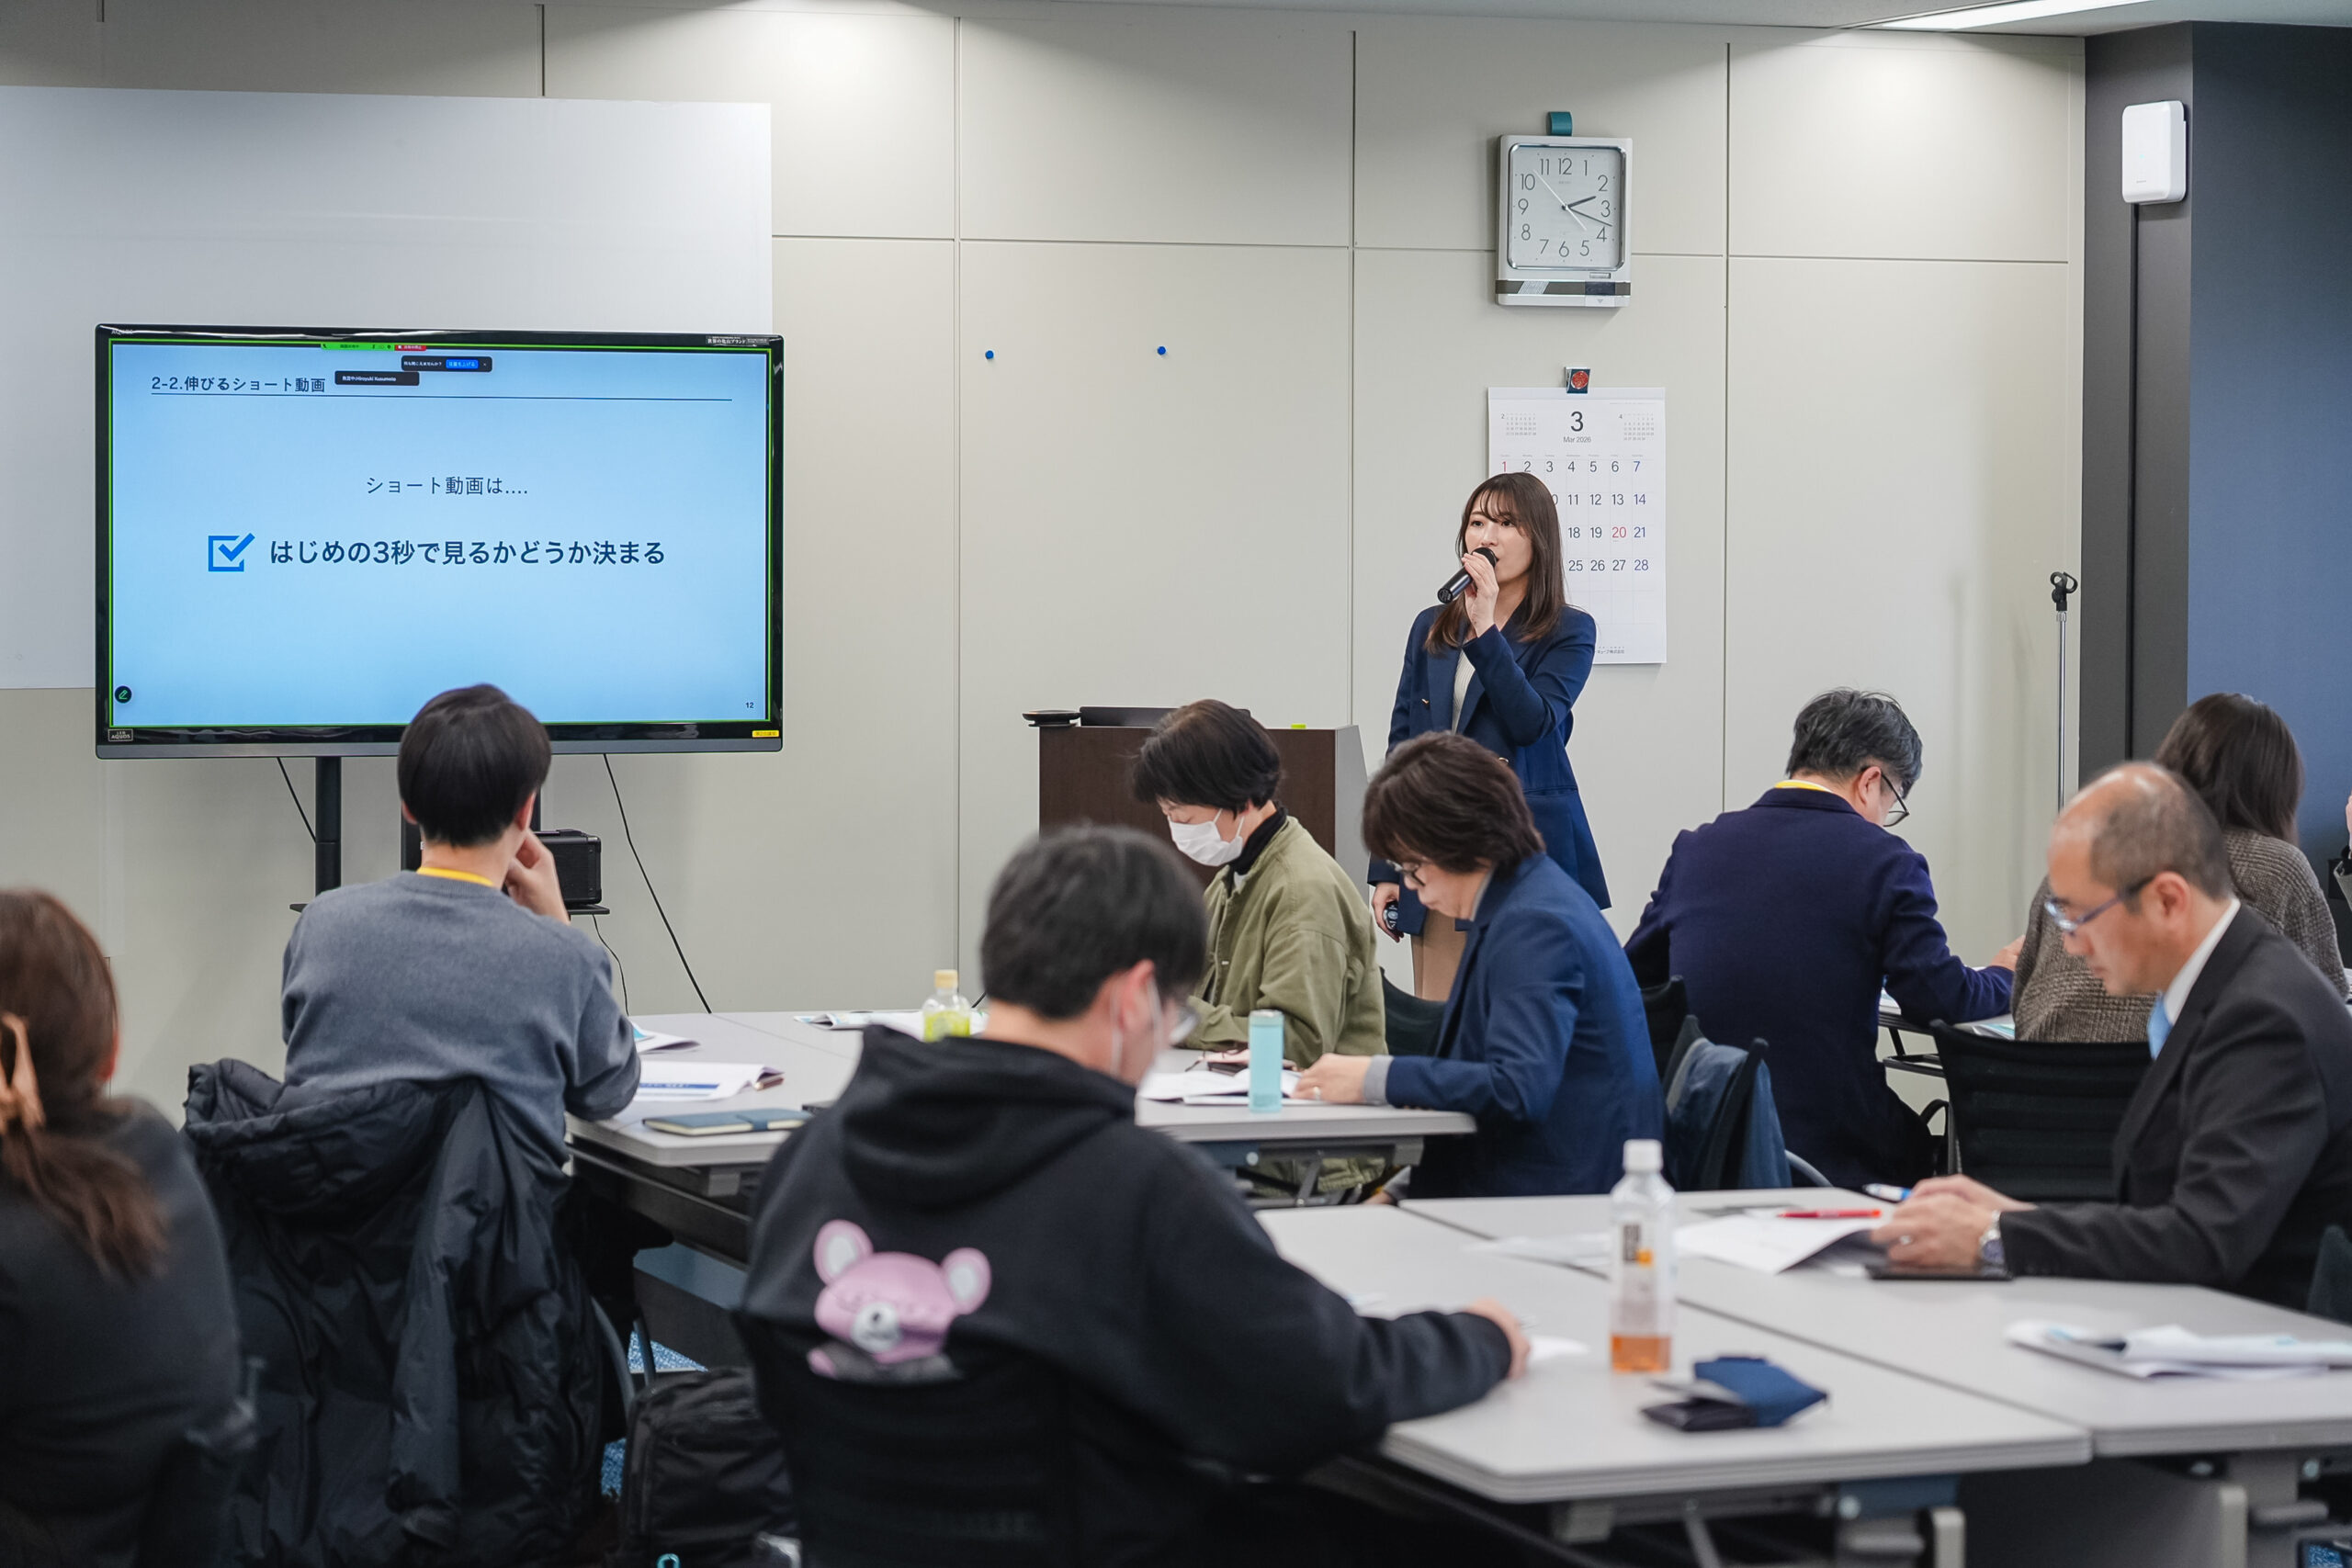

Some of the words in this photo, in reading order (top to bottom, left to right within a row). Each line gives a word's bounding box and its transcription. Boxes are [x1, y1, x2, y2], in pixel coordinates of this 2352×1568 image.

[1540, 158, 1550, 175] 11
[1557, 157, 1573, 175] 12
[1584, 159, 1588, 176] 1
[1521, 173, 1536, 191] 10
[1597, 174, 1609, 192] 2
[1518, 197, 1529, 216] 9
[1600, 199, 1611, 218] 3
[1521, 223, 1532, 241] 8
[1596, 226, 1608, 243] 4
[1539, 238, 1550, 254] 7
[1558, 241, 1570, 258] 6
[1579, 240, 1590, 257] 5
[152, 376, 326, 393] 2-2.伸びるショート動画
[1570, 411, 1584, 433] 3
[1563, 435, 1575, 444] Mar
[1576, 435, 1592, 444] 2026
[1501, 461, 1507, 472] 1
[1523, 460, 1532, 472] 2
[1545, 460, 1554, 472] 3
[1567, 460, 1576, 472] 4
[1589, 460, 1598, 472] 5
[1611, 460, 1620, 472] 6
[1634, 460, 1641, 472] 7
[367, 476, 528, 496] ショート動画は....
[1567, 494, 1578, 505] 11
[1589, 493, 1602, 505] 12
[1612, 493, 1624, 505] 13
[1634, 493, 1646, 505] 14
[1567, 526, 1581, 538] 18
[1589, 526, 1602, 538] 19
[1611, 526, 1627, 538] 20
[1634, 526, 1645, 538] 21
[271, 539, 665, 566] はじめの3秒で見るかどうか決まる
[1568, 559, 1584, 571] 25
[1590, 559, 1605, 571] 26
[1611, 559, 1626, 571] 27
[1634, 559, 1649, 571] 28
